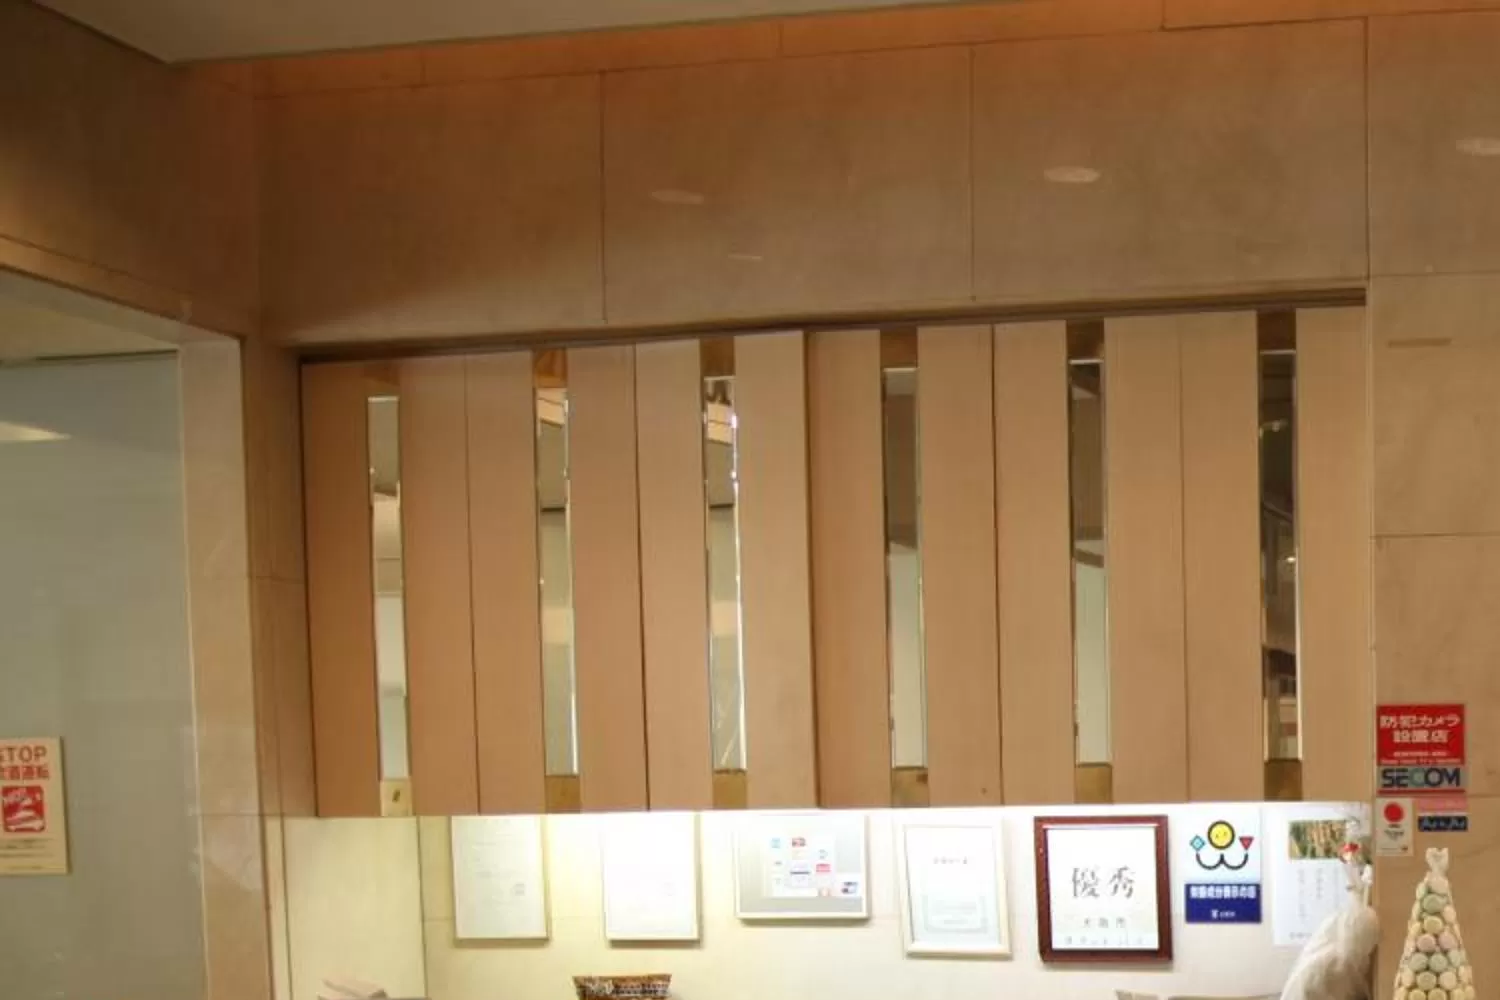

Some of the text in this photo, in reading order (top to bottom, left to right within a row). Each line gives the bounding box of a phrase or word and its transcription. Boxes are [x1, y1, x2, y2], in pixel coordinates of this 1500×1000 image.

[1380, 714, 1461, 729] 防犯カメラ
[1381, 767, 1462, 788] SECOM
[1071, 866, 1137, 899] 優秀
